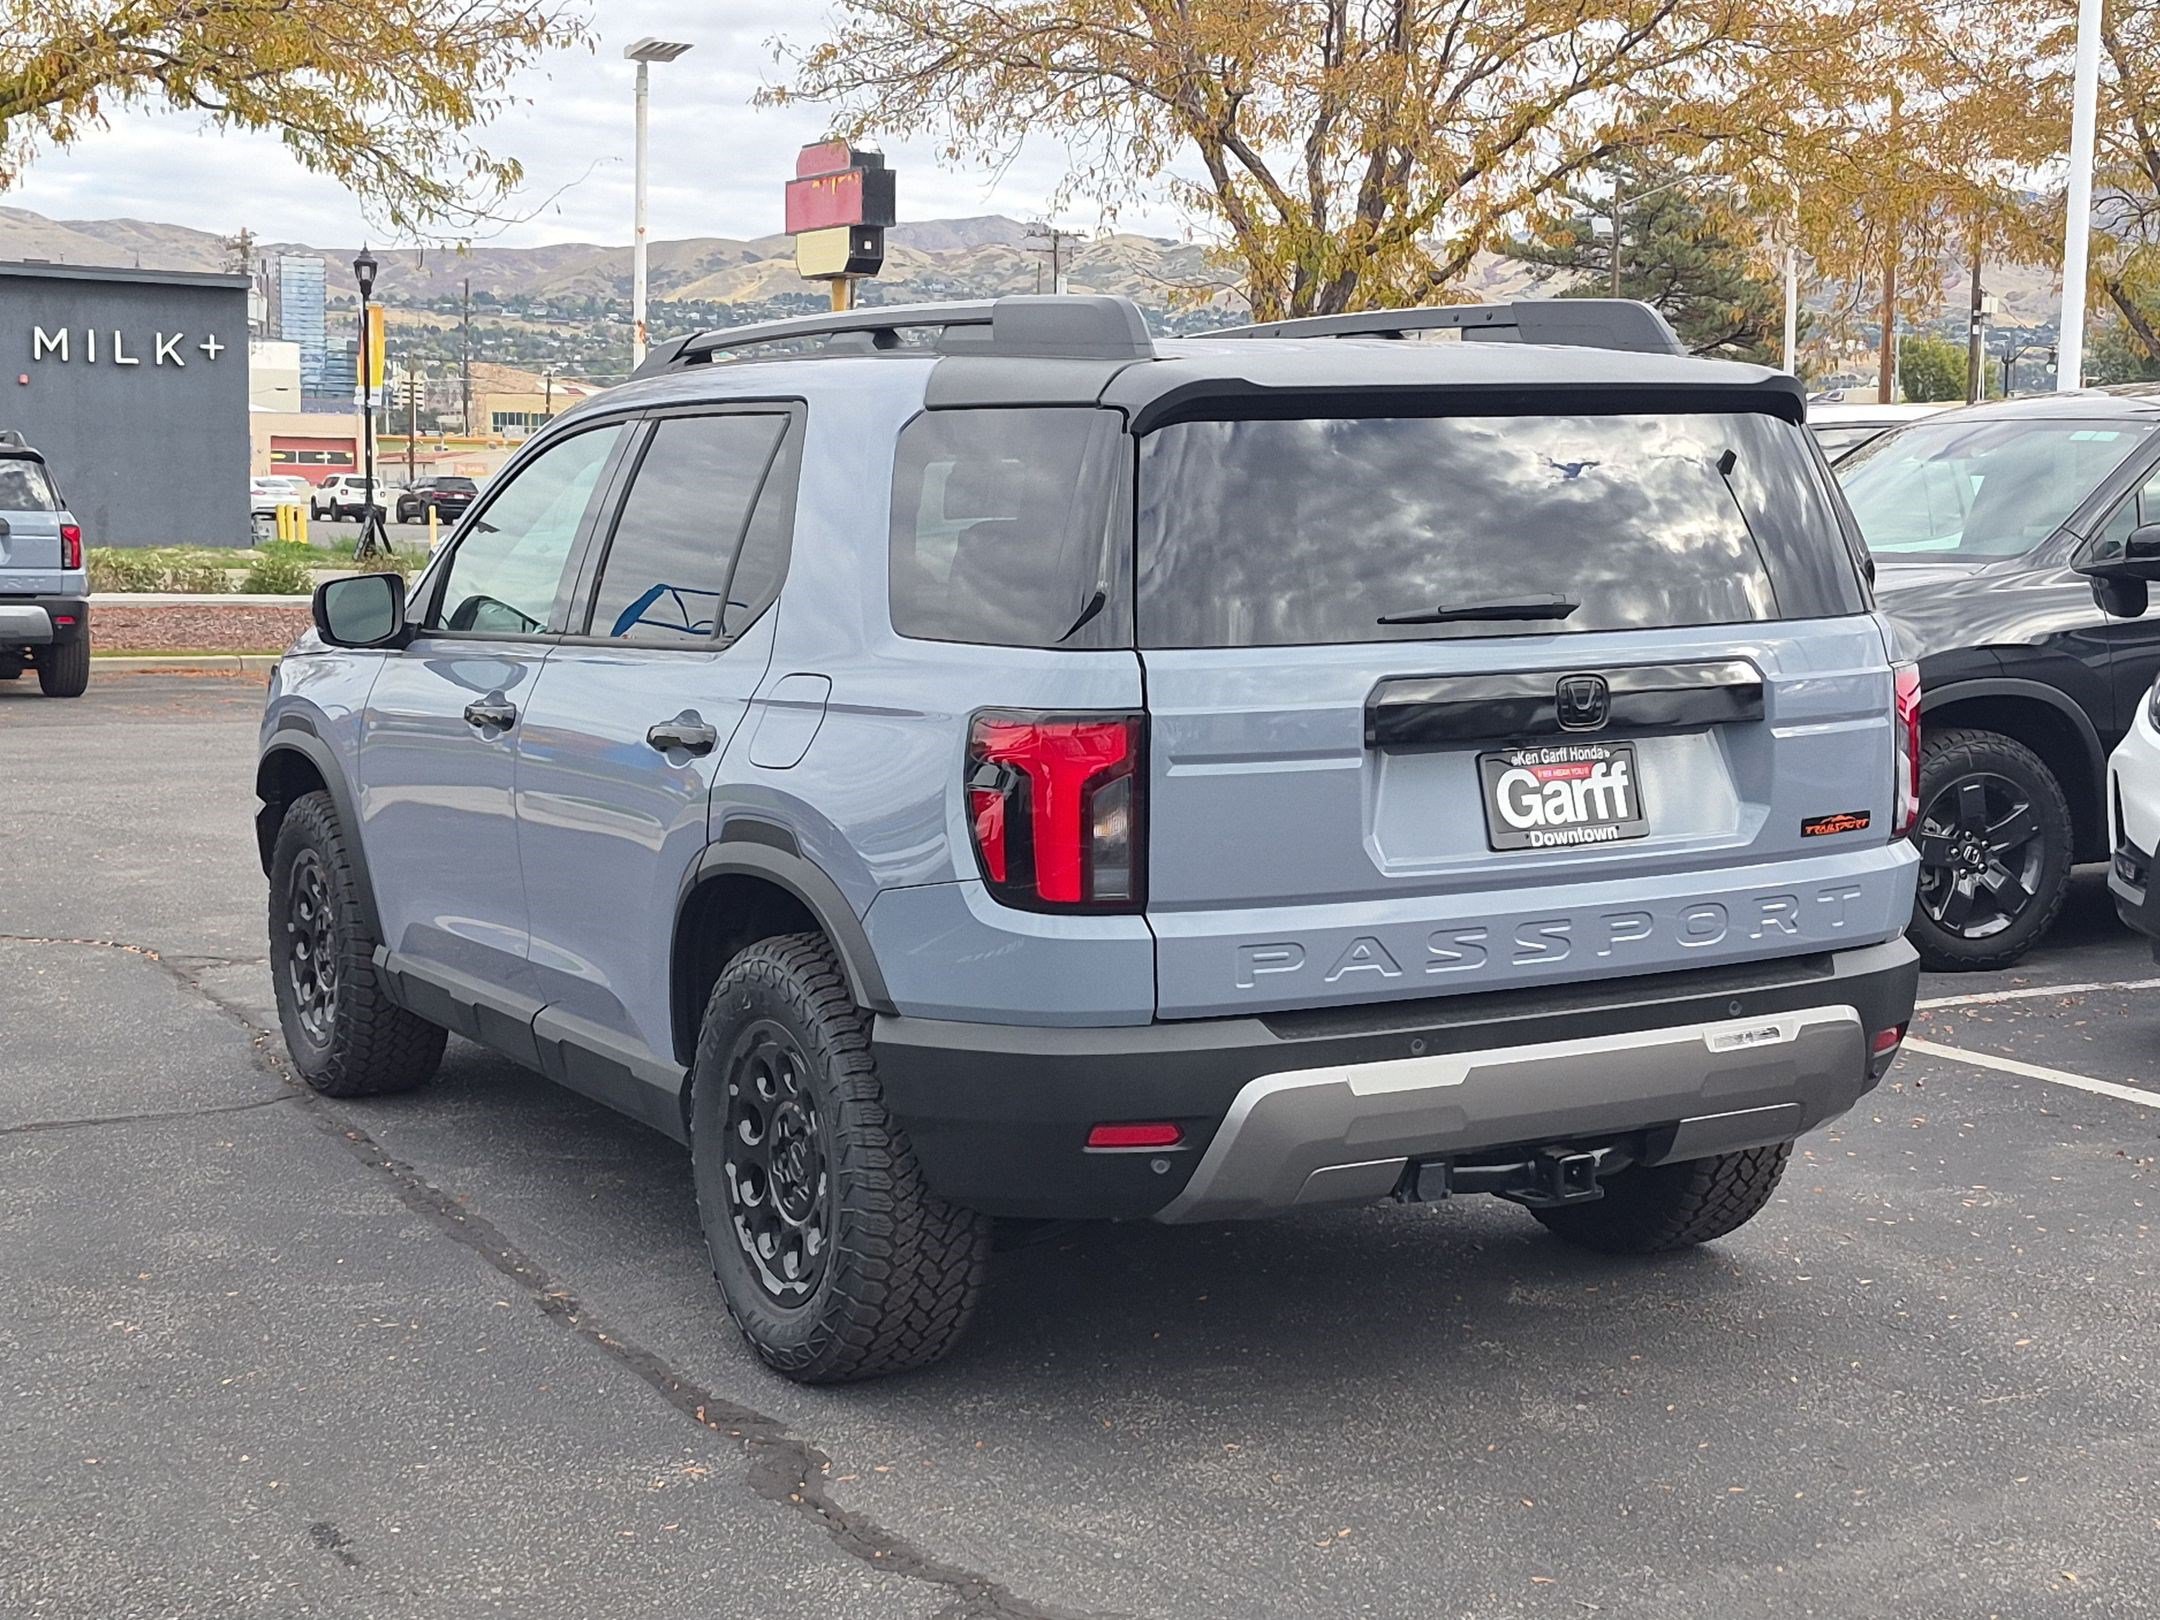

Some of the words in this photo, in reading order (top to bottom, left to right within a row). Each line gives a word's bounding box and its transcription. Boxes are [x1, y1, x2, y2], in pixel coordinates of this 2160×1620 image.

[1517, 750, 1539, 766] Ken
[1540, 747, 1568, 764] Garff
[1569, 745, 1604, 762] Honda
[1496, 760, 1629, 829] Garff
[1530, 825, 1619, 847] Downtown
[1234, 884, 1862, 989] PASSPORT
